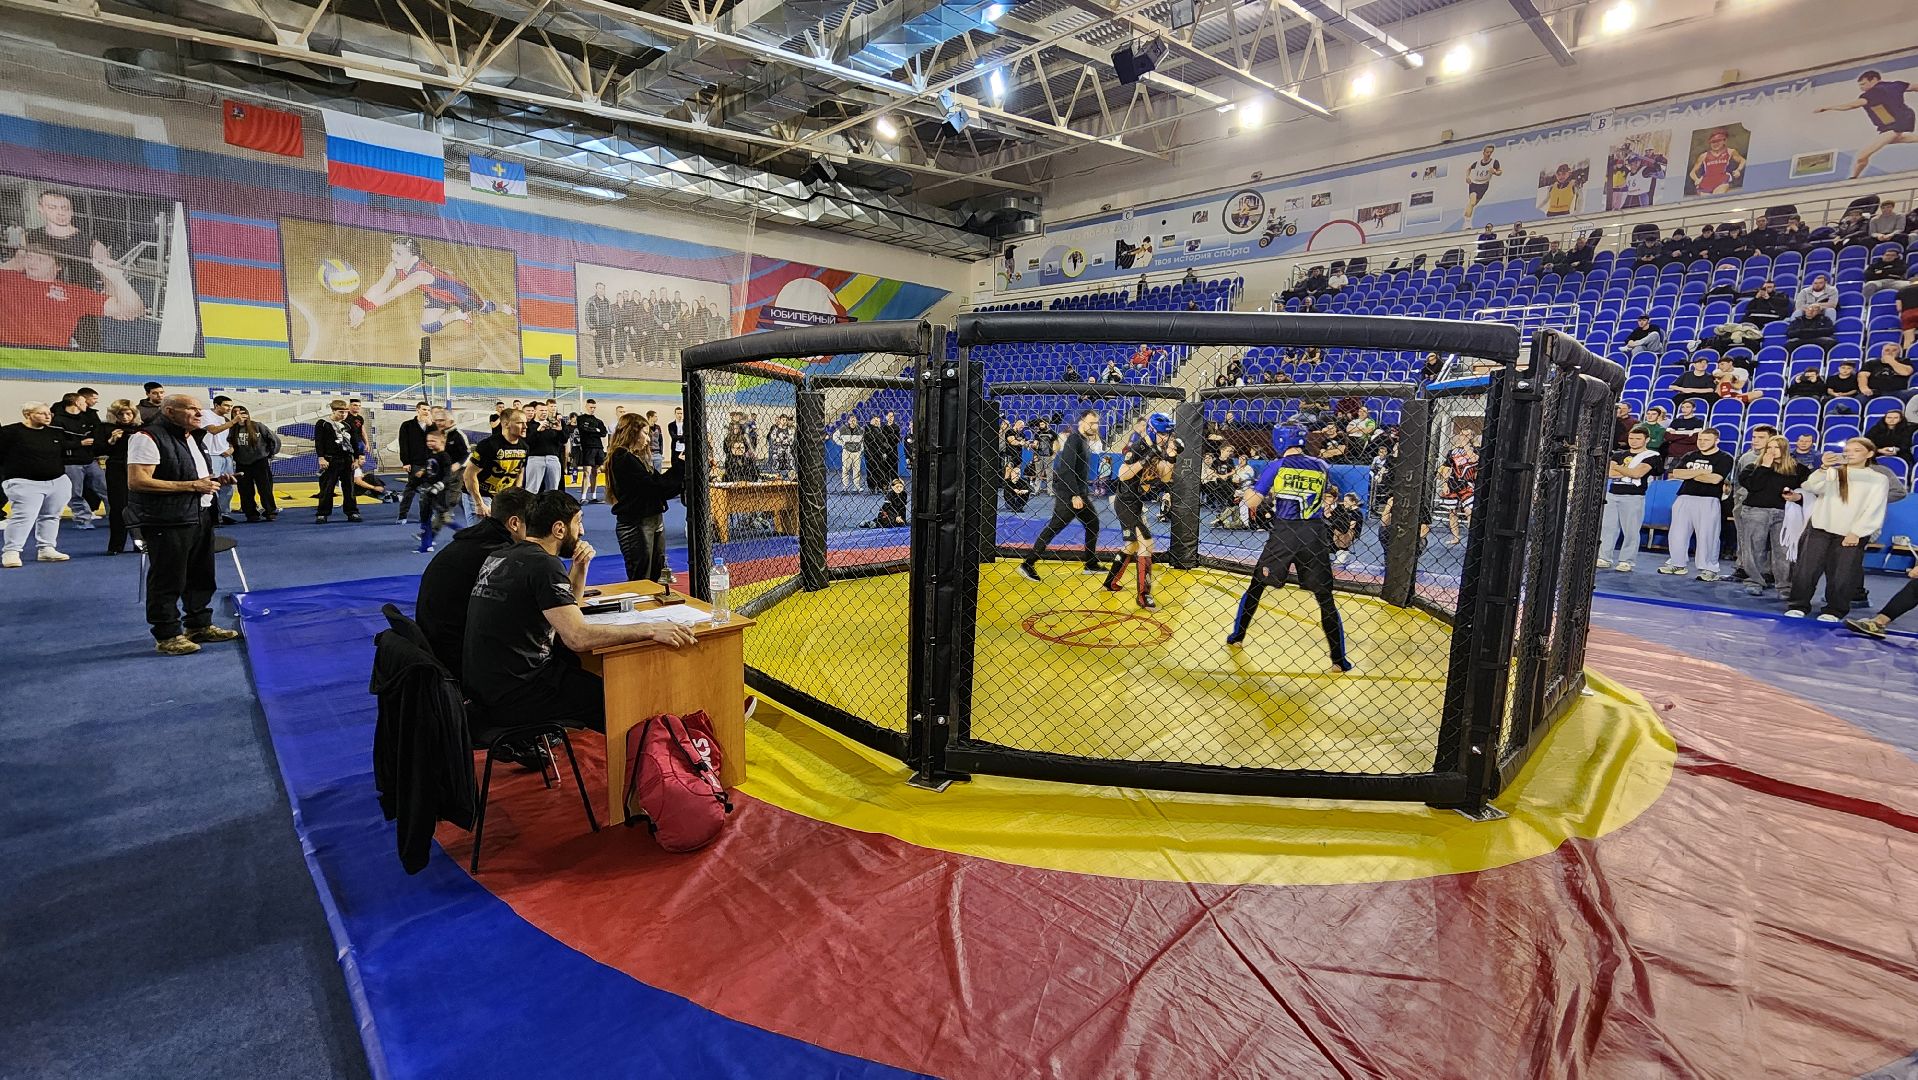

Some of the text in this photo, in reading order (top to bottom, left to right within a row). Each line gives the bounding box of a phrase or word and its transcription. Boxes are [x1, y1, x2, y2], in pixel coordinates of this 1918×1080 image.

[1173, 250, 1212, 264] история
[1213, 246, 1250, 260] спорта
[770, 308, 836, 325] ЮБИЛЕЙНЫЙ
[1283, 480, 1318, 491] HILL
[1284, 473, 1323, 486] GREEN
